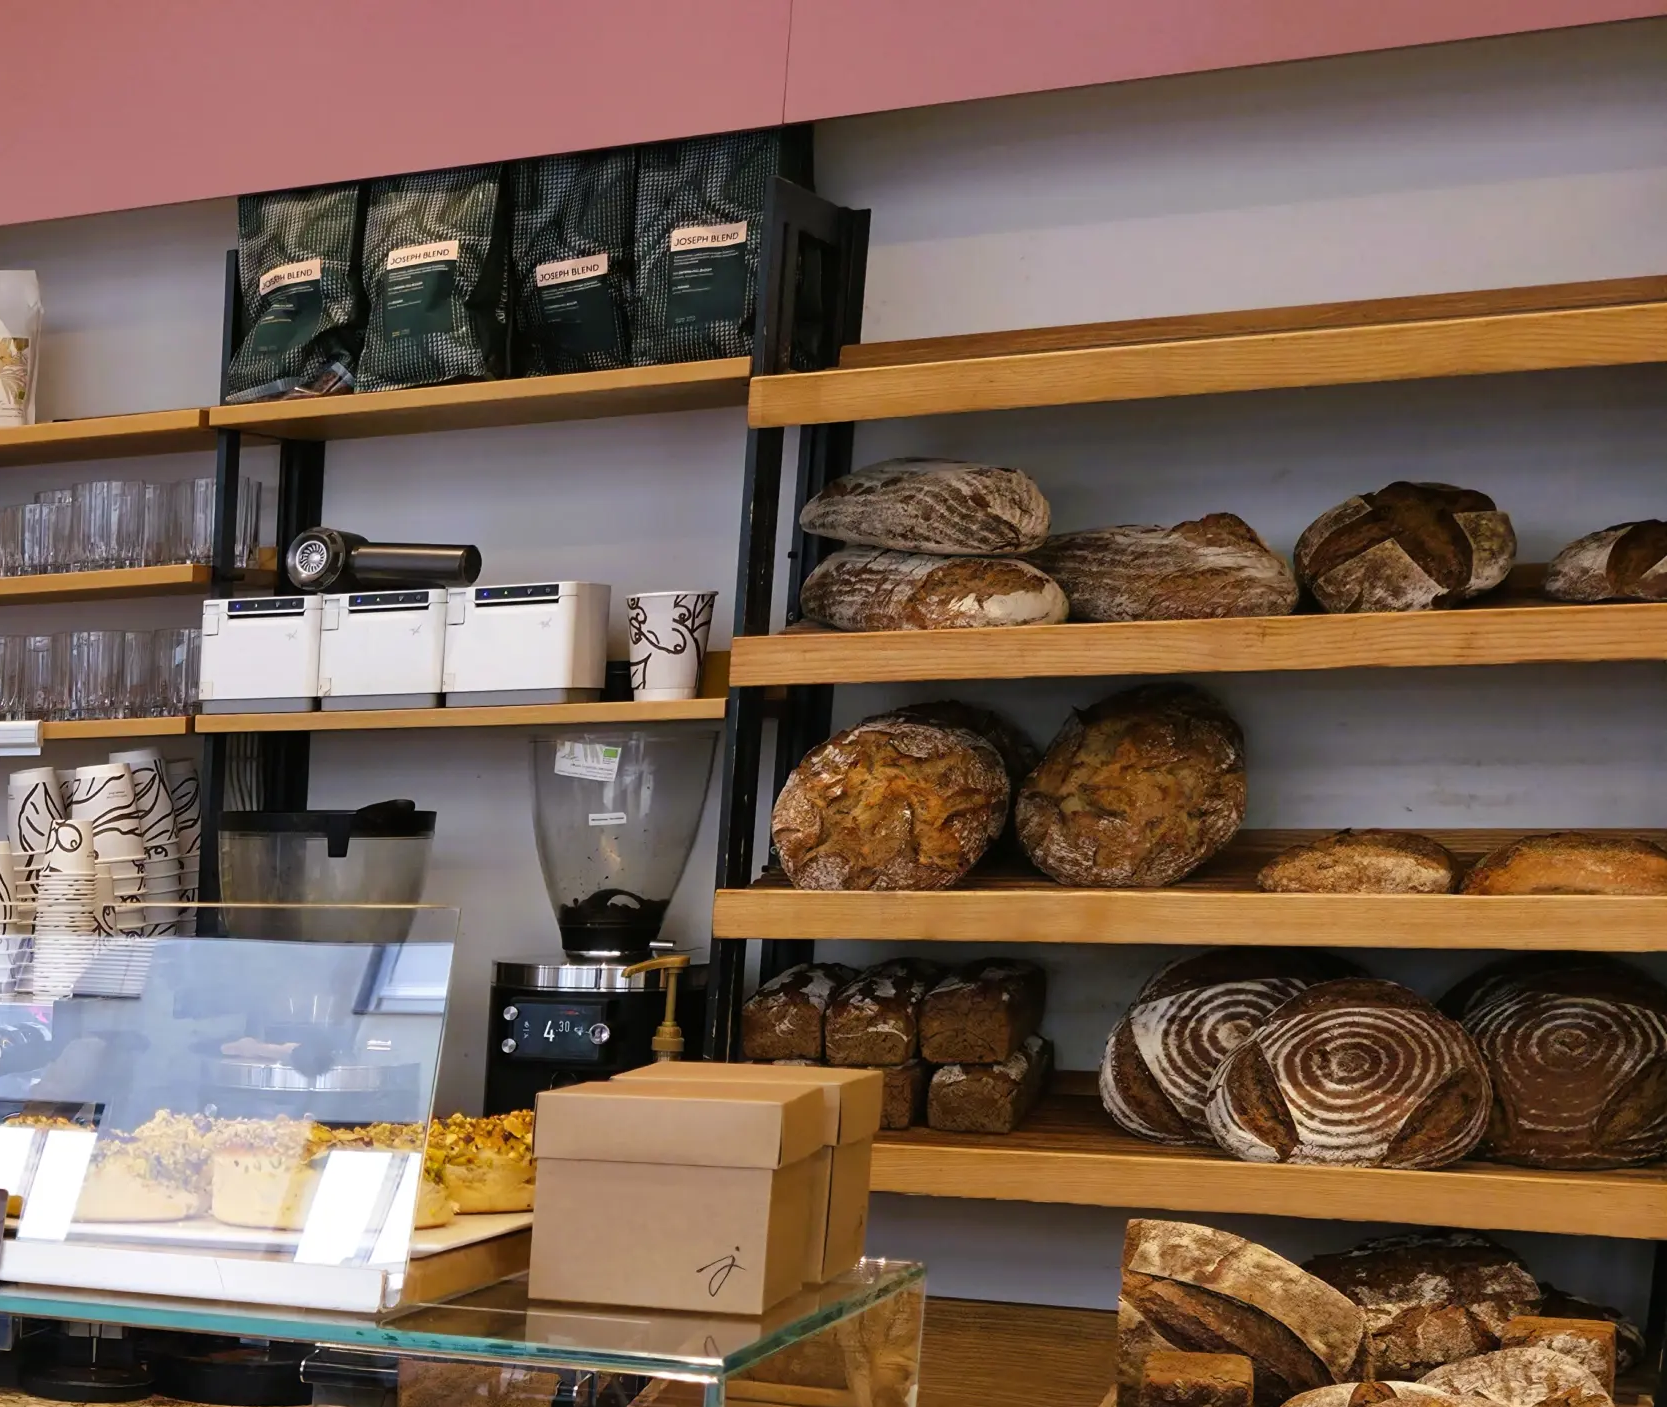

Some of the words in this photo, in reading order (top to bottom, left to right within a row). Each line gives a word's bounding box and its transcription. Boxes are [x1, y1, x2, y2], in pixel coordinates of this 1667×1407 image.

[673, 234, 709, 248] JOSEPH
[710, 231, 740, 244] BLEND
[389, 252, 422, 265] JOSEPH
[423, 248, 450, 260] BLEND
[287, 268, 313, 282] BLEND
[539, 268, 569, 283] JOSEPH
[570, 263, 600, 277] BLEND
